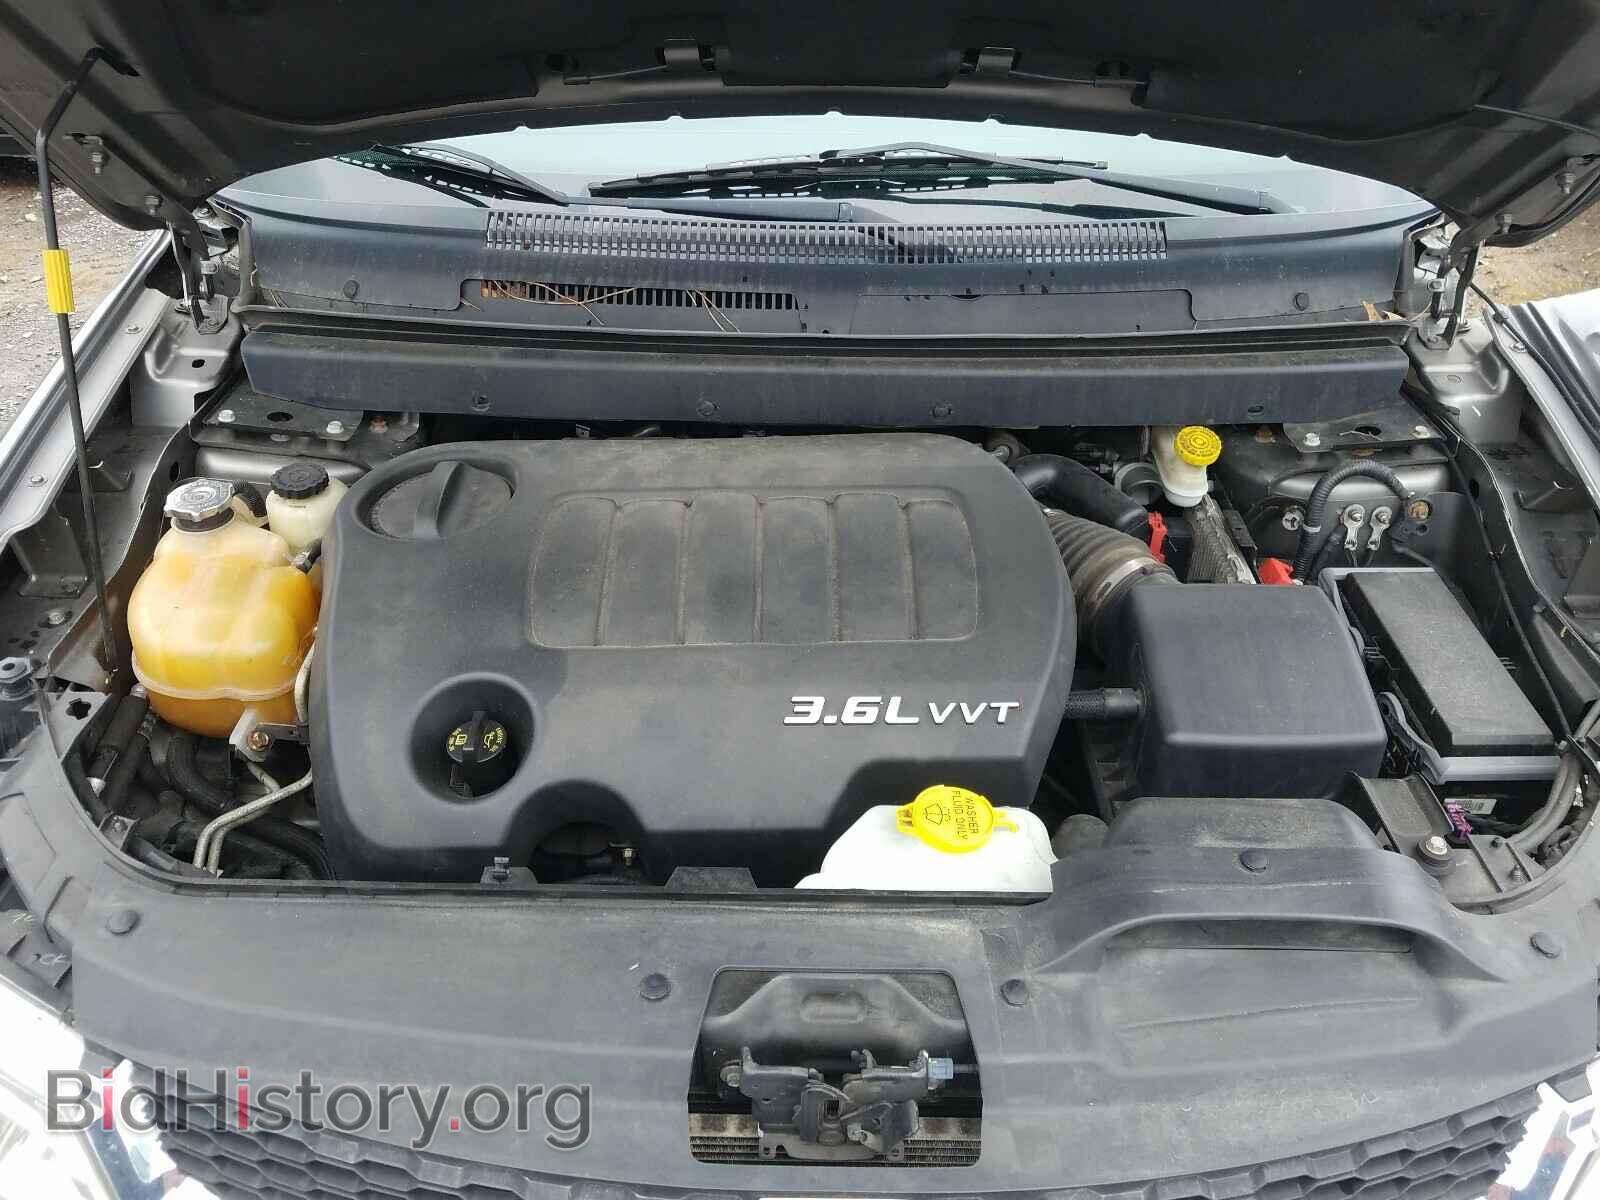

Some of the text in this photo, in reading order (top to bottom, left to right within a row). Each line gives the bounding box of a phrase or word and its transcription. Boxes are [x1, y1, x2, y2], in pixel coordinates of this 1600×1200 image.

[783, 695, 1020, 725] 3.6L VVT
[952, 790, 968, 840] FLUID ONLY
[965, 797, 979, 834] WASHER
